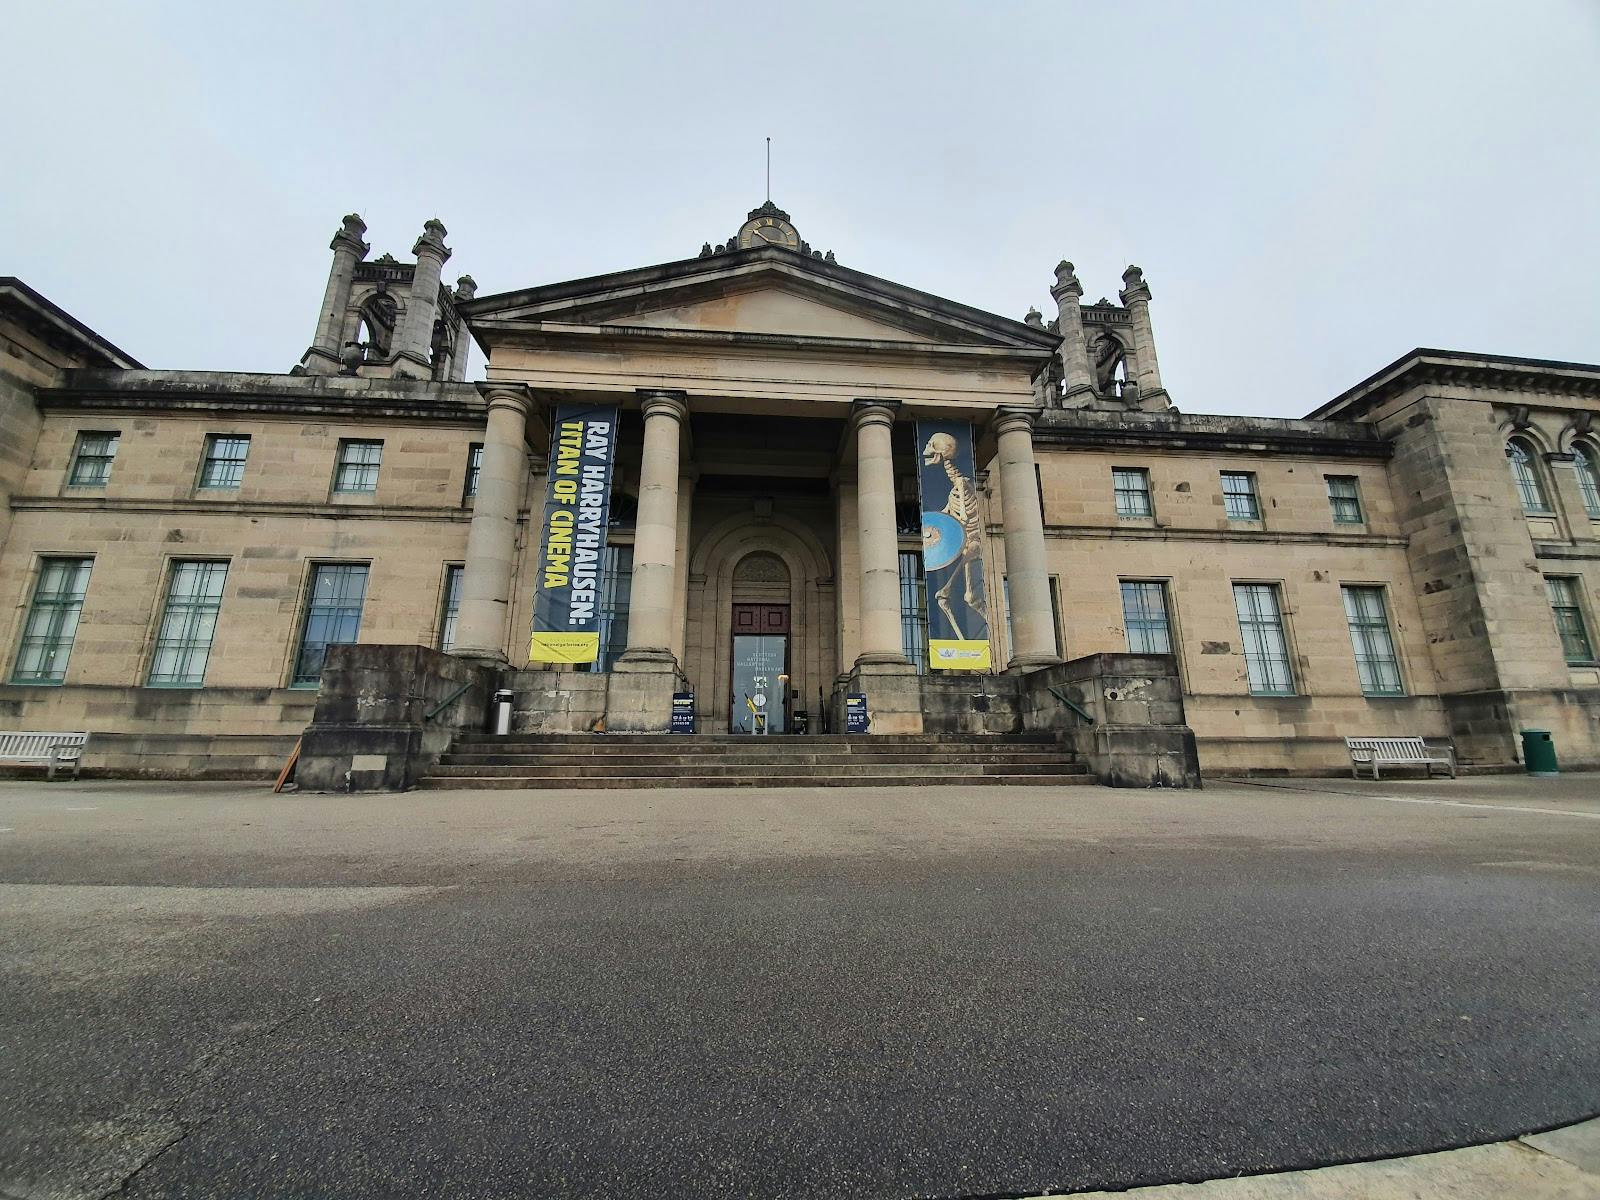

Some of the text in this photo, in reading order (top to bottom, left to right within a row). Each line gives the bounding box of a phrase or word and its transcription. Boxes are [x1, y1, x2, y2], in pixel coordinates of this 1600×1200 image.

[544, 421, 584, 589] TITAN OF CINEMA
[569, 421, 610, 625] RAY HARRYHAUSEN:
